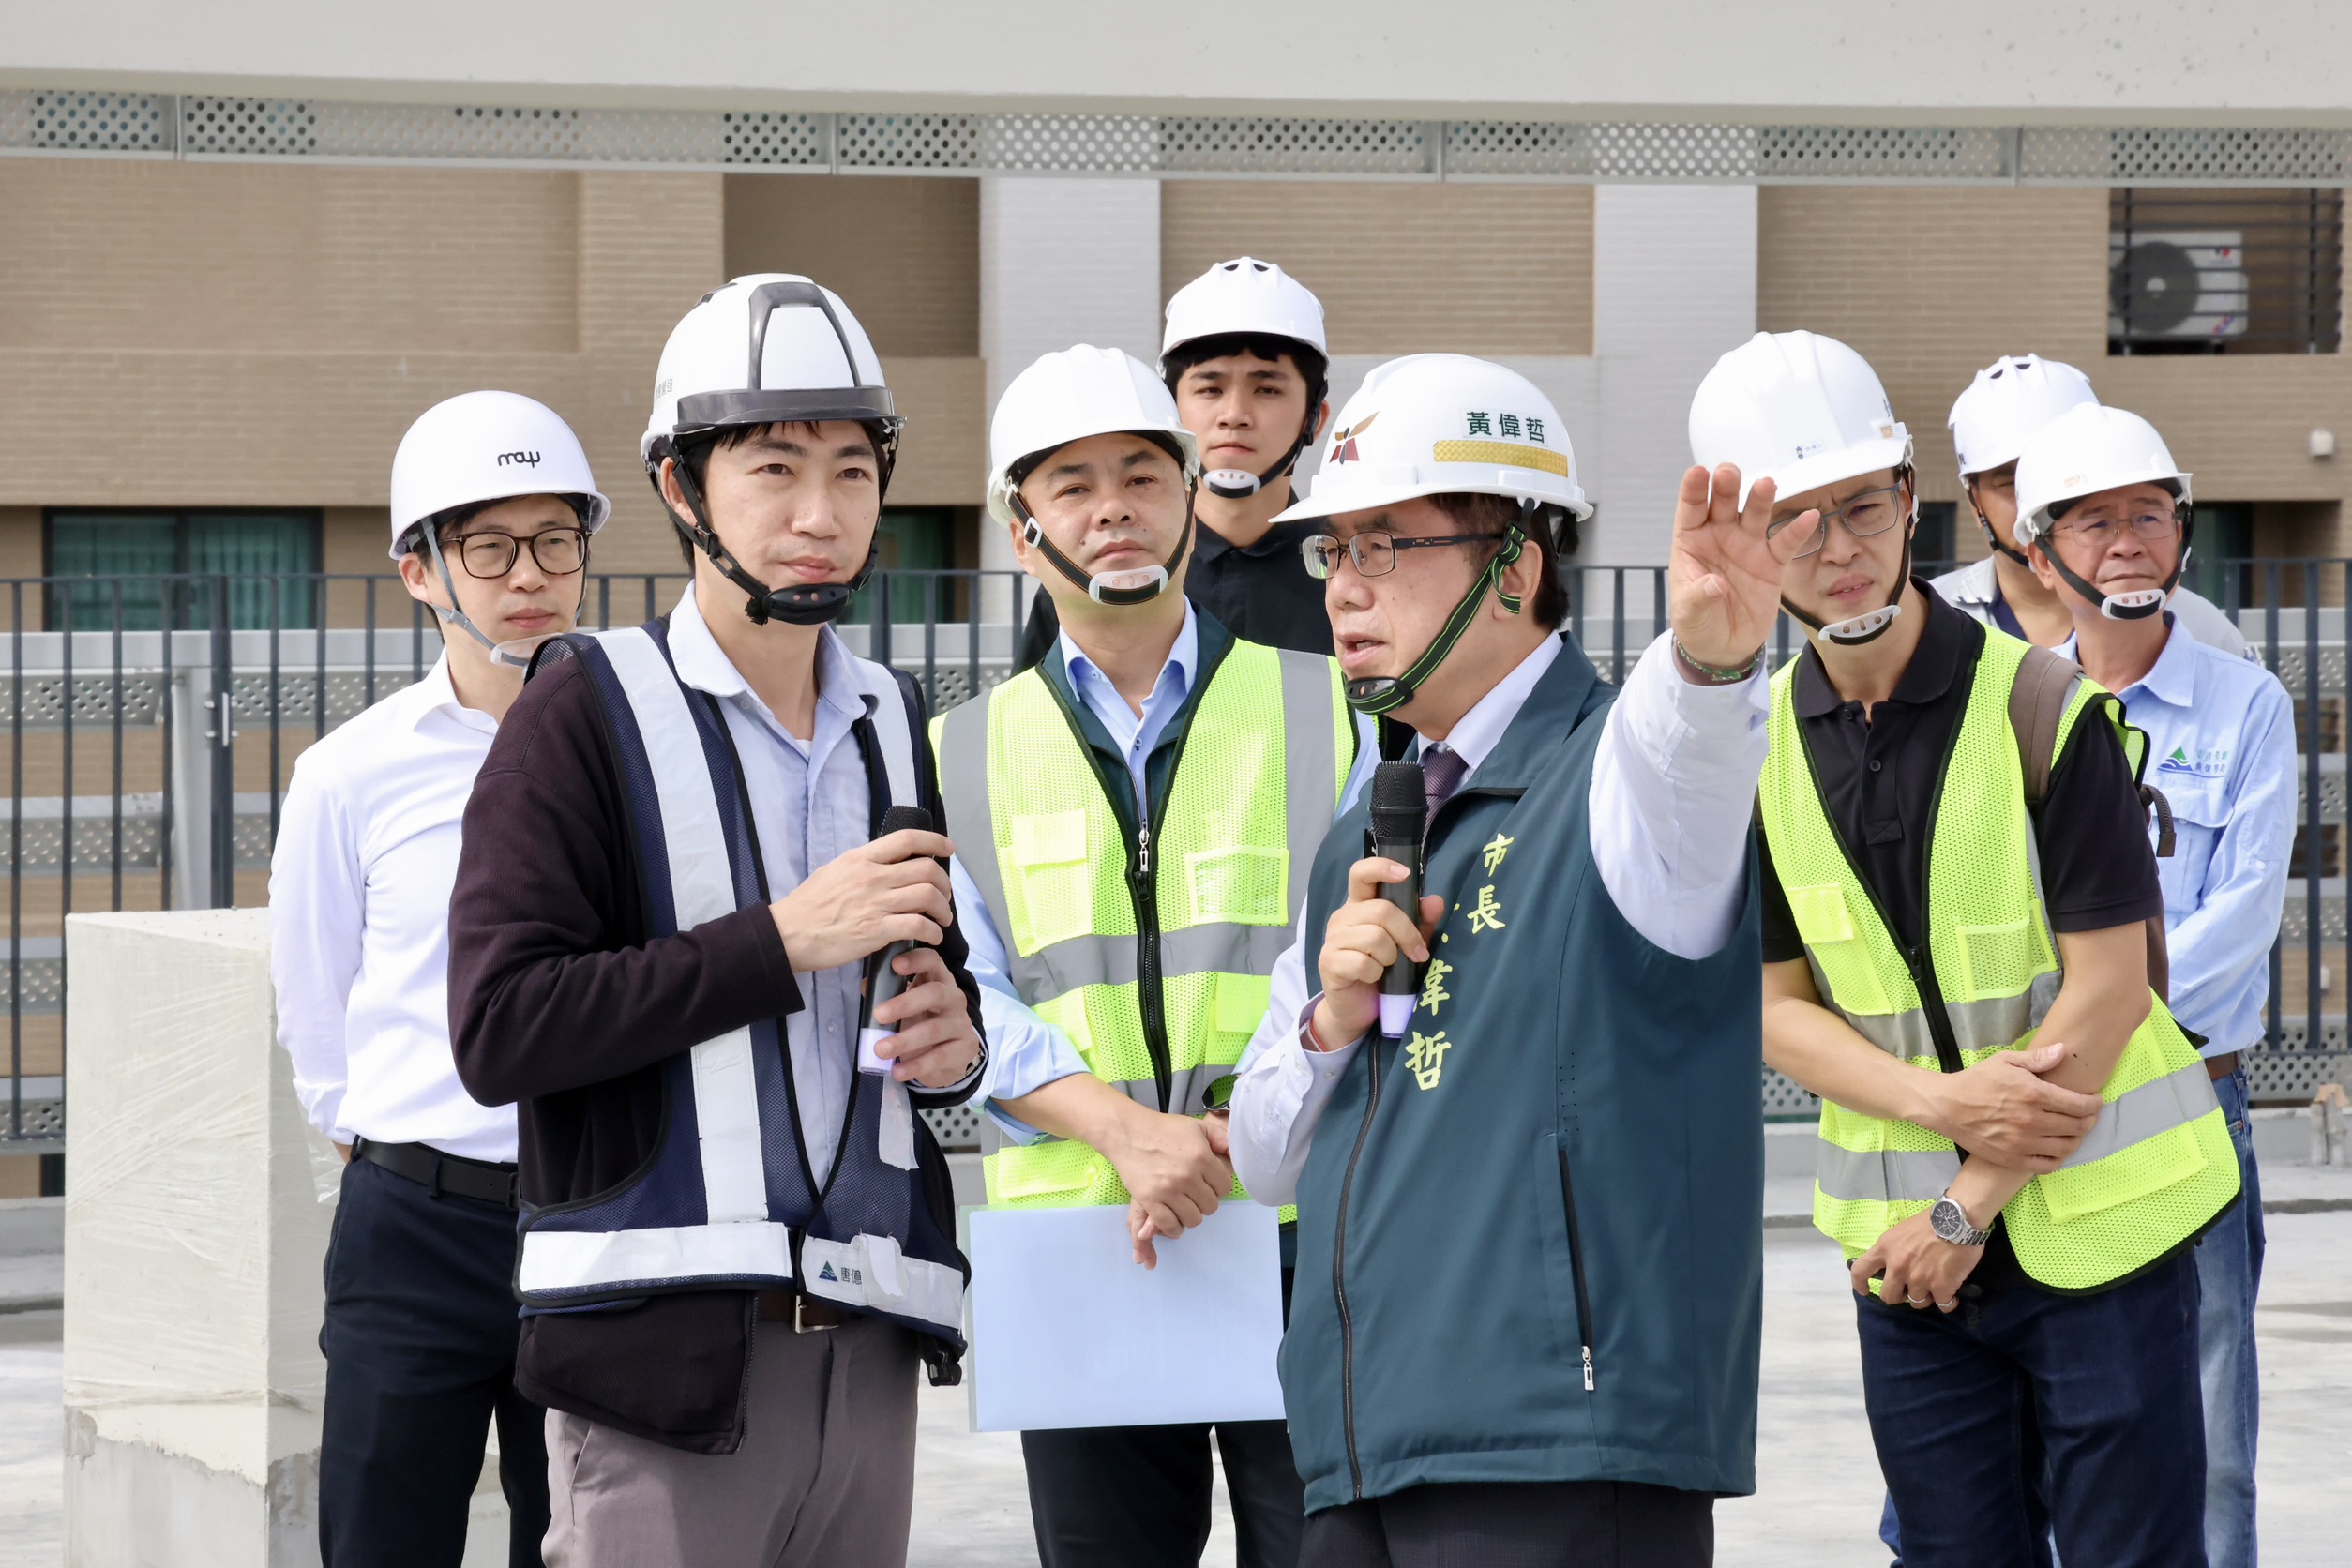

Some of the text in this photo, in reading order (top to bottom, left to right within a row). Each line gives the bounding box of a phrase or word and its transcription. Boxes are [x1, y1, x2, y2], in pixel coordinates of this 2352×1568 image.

[1467, 411, 1545, 444] 黃偉哲
[1466, 833, 1515, 934] 市長
[1405, 903, 1460, 1091] 偉哲
